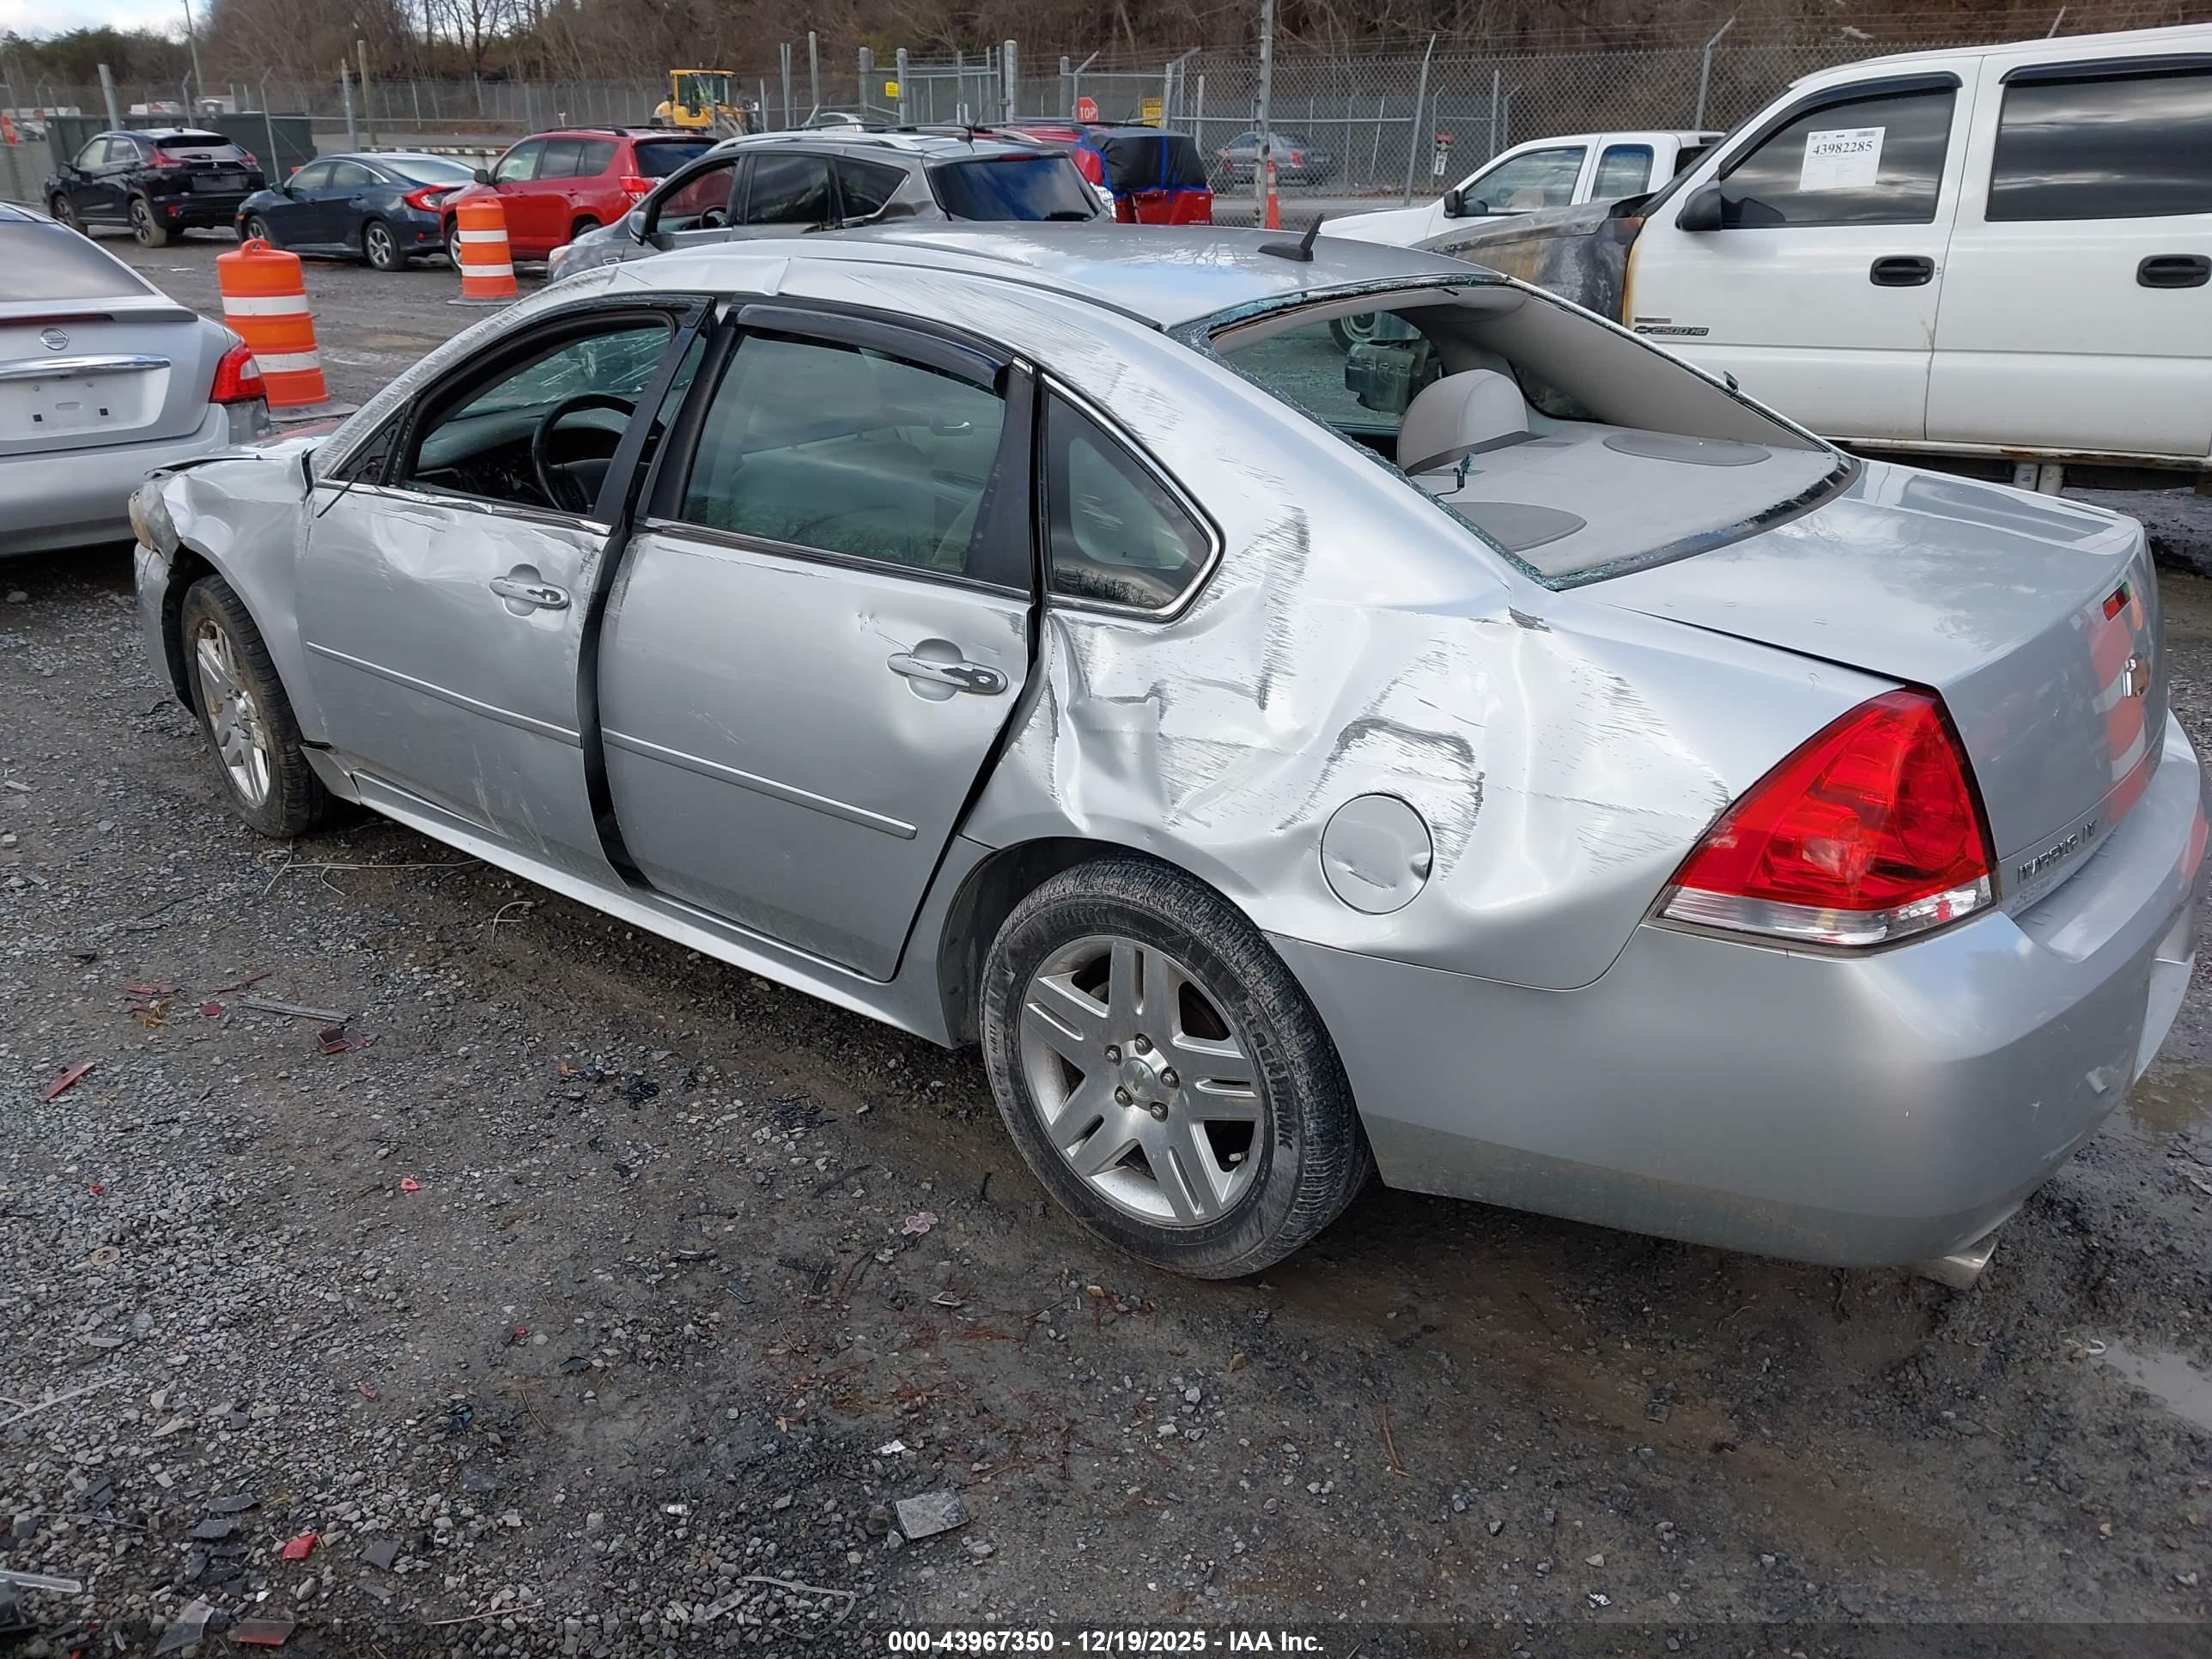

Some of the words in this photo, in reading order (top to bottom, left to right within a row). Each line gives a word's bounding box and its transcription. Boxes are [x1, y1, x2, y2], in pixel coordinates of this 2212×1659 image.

[1077, 106, 1097, 118] TOP
[1812, 141, 1874, 155] 43982285
[1651, 326, 1689, 335] 2500
